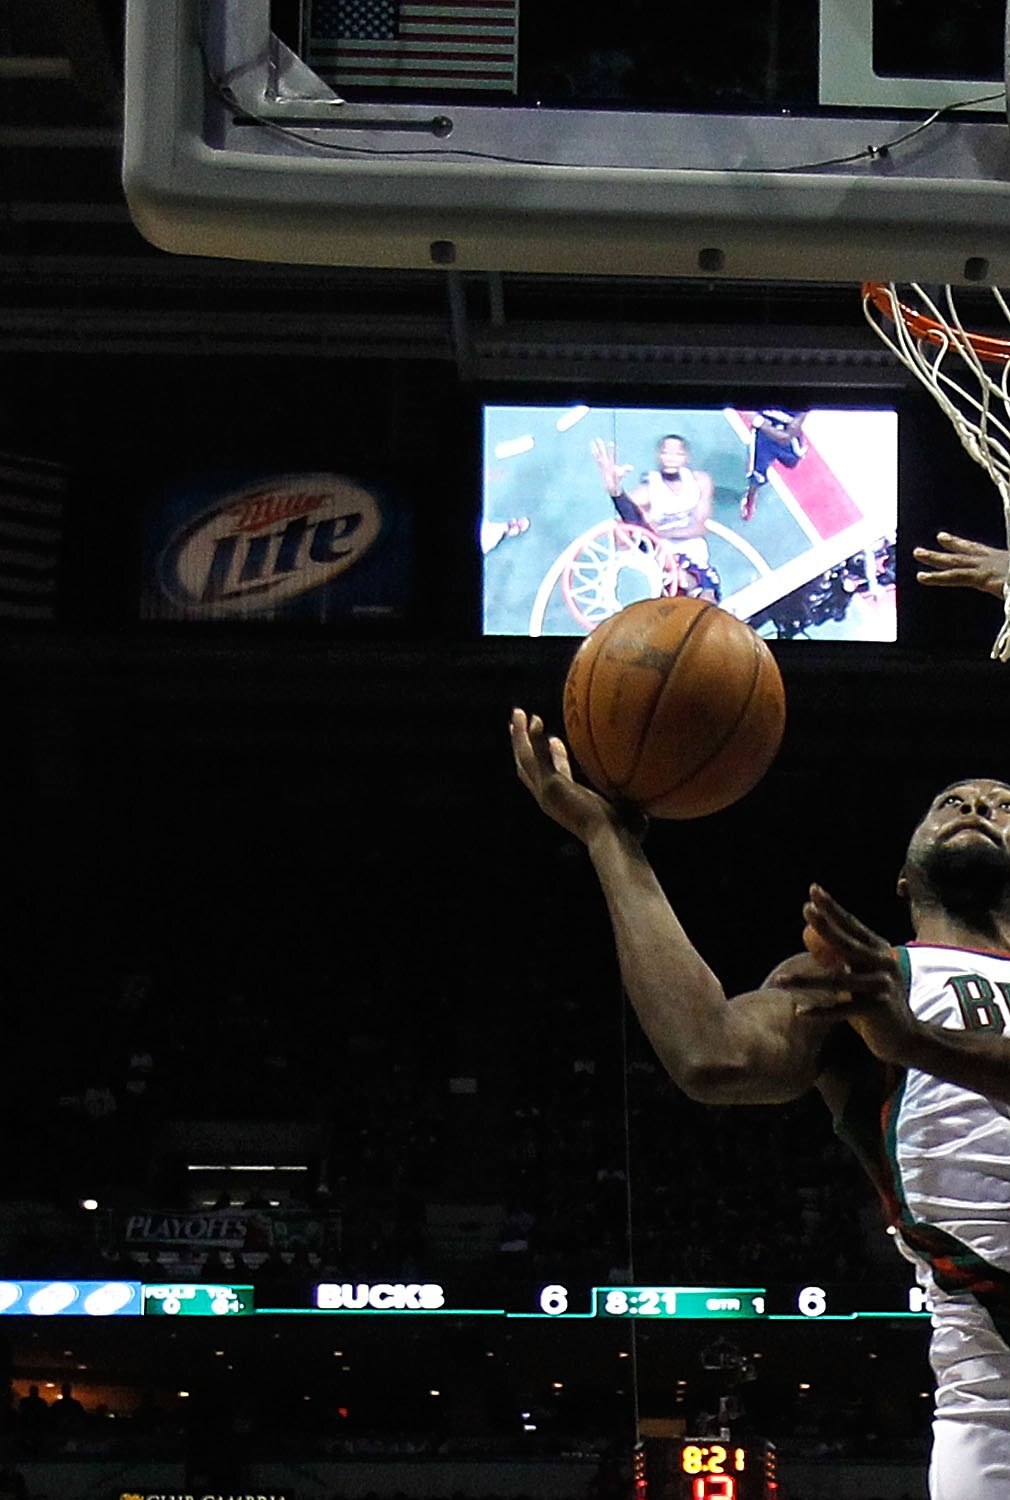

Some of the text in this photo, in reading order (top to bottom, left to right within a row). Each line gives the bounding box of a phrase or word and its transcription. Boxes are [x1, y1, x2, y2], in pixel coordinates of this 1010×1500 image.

[200, 513, 363, 604] Lite
[125, 1215, 247, 1240] PLAYOFFS
[317, 1283, 445, 1309] BUCKS
[540, 1284, 568, 1315] 6
[605, 1290, 677, 1315] 8:21
[752, 1297, 765, 1314] 1
[798, 1286, 826, 1317] 6
[682, 1444, 745, 1475] 8:21
